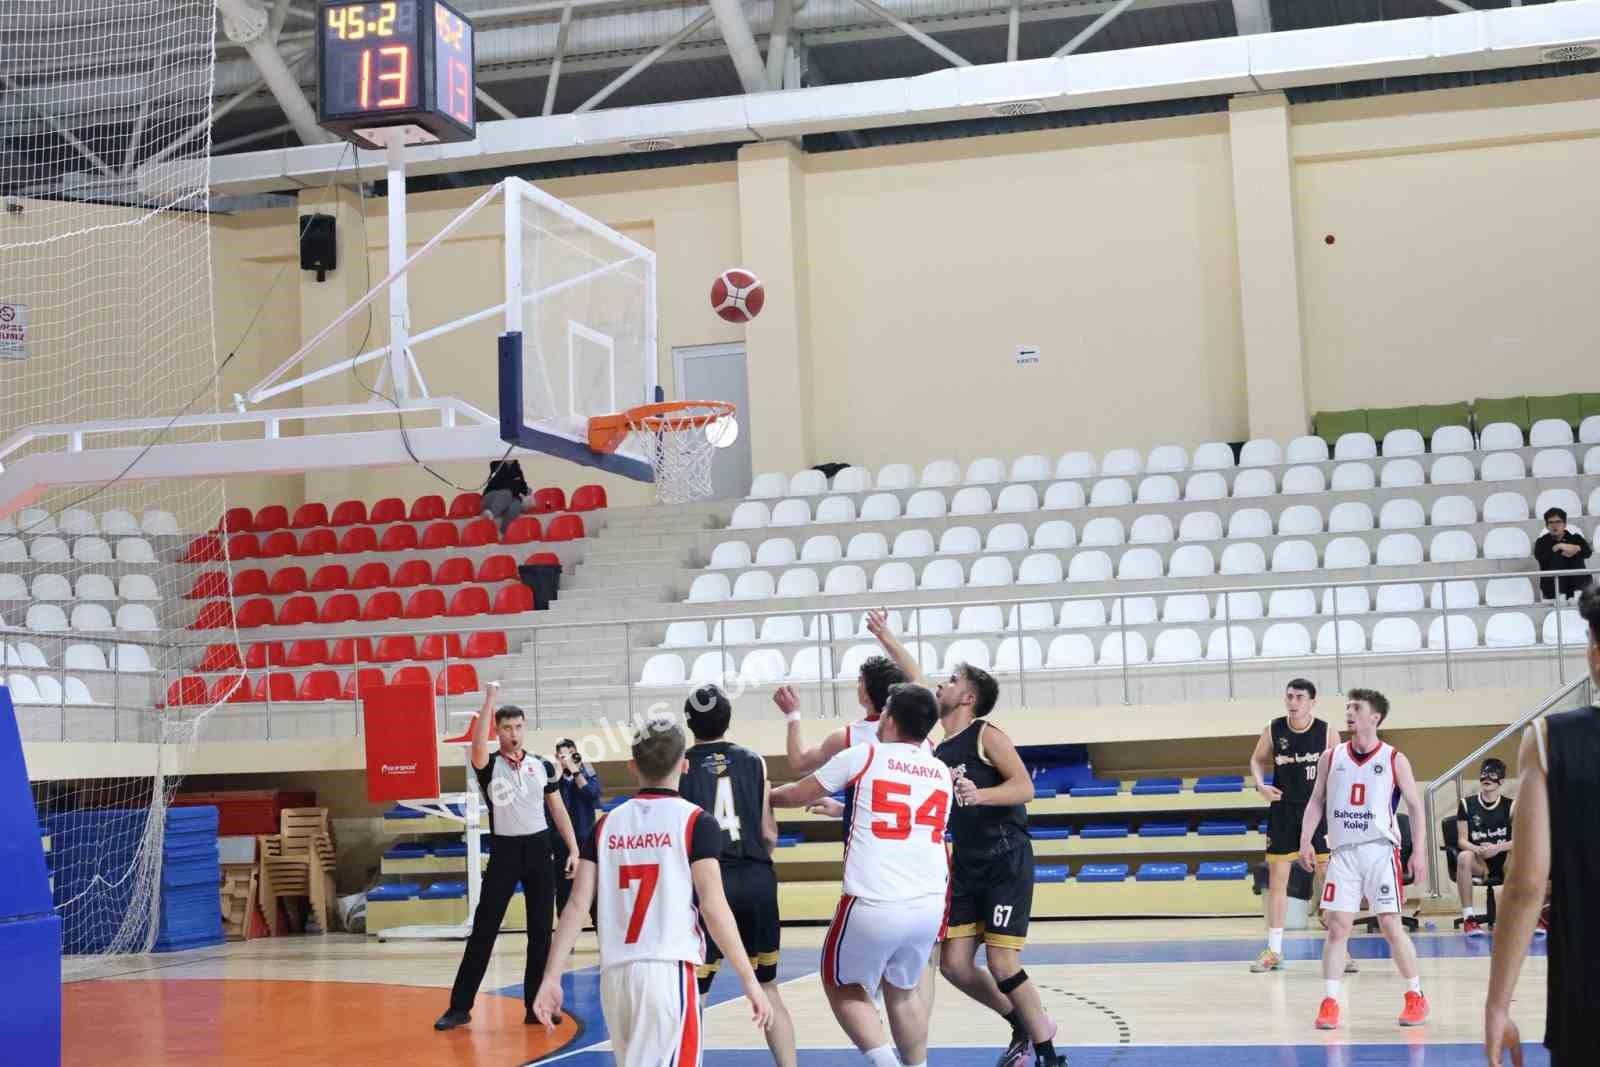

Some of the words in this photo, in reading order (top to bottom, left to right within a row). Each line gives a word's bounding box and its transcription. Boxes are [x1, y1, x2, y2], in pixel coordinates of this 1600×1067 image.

[328, 2, 397, 40] 45.2
[360, 46, 409, 110] 13
[448, 58, 469, 123] 13
[887, 757, 943, 780] SAKARYA
[1305, 765, 1317, 781] 10
[713, 775, 742, 842] 4
[1350, 783, 1366, 806] 0
[871, 779, 948, 843] 54
[1343, 820, 1369, 832] Koleji
[608, 832, 672, 850] SAKARYA
[619, 863, 660, 944] 7
[993, 903, 1014, 928] 67
